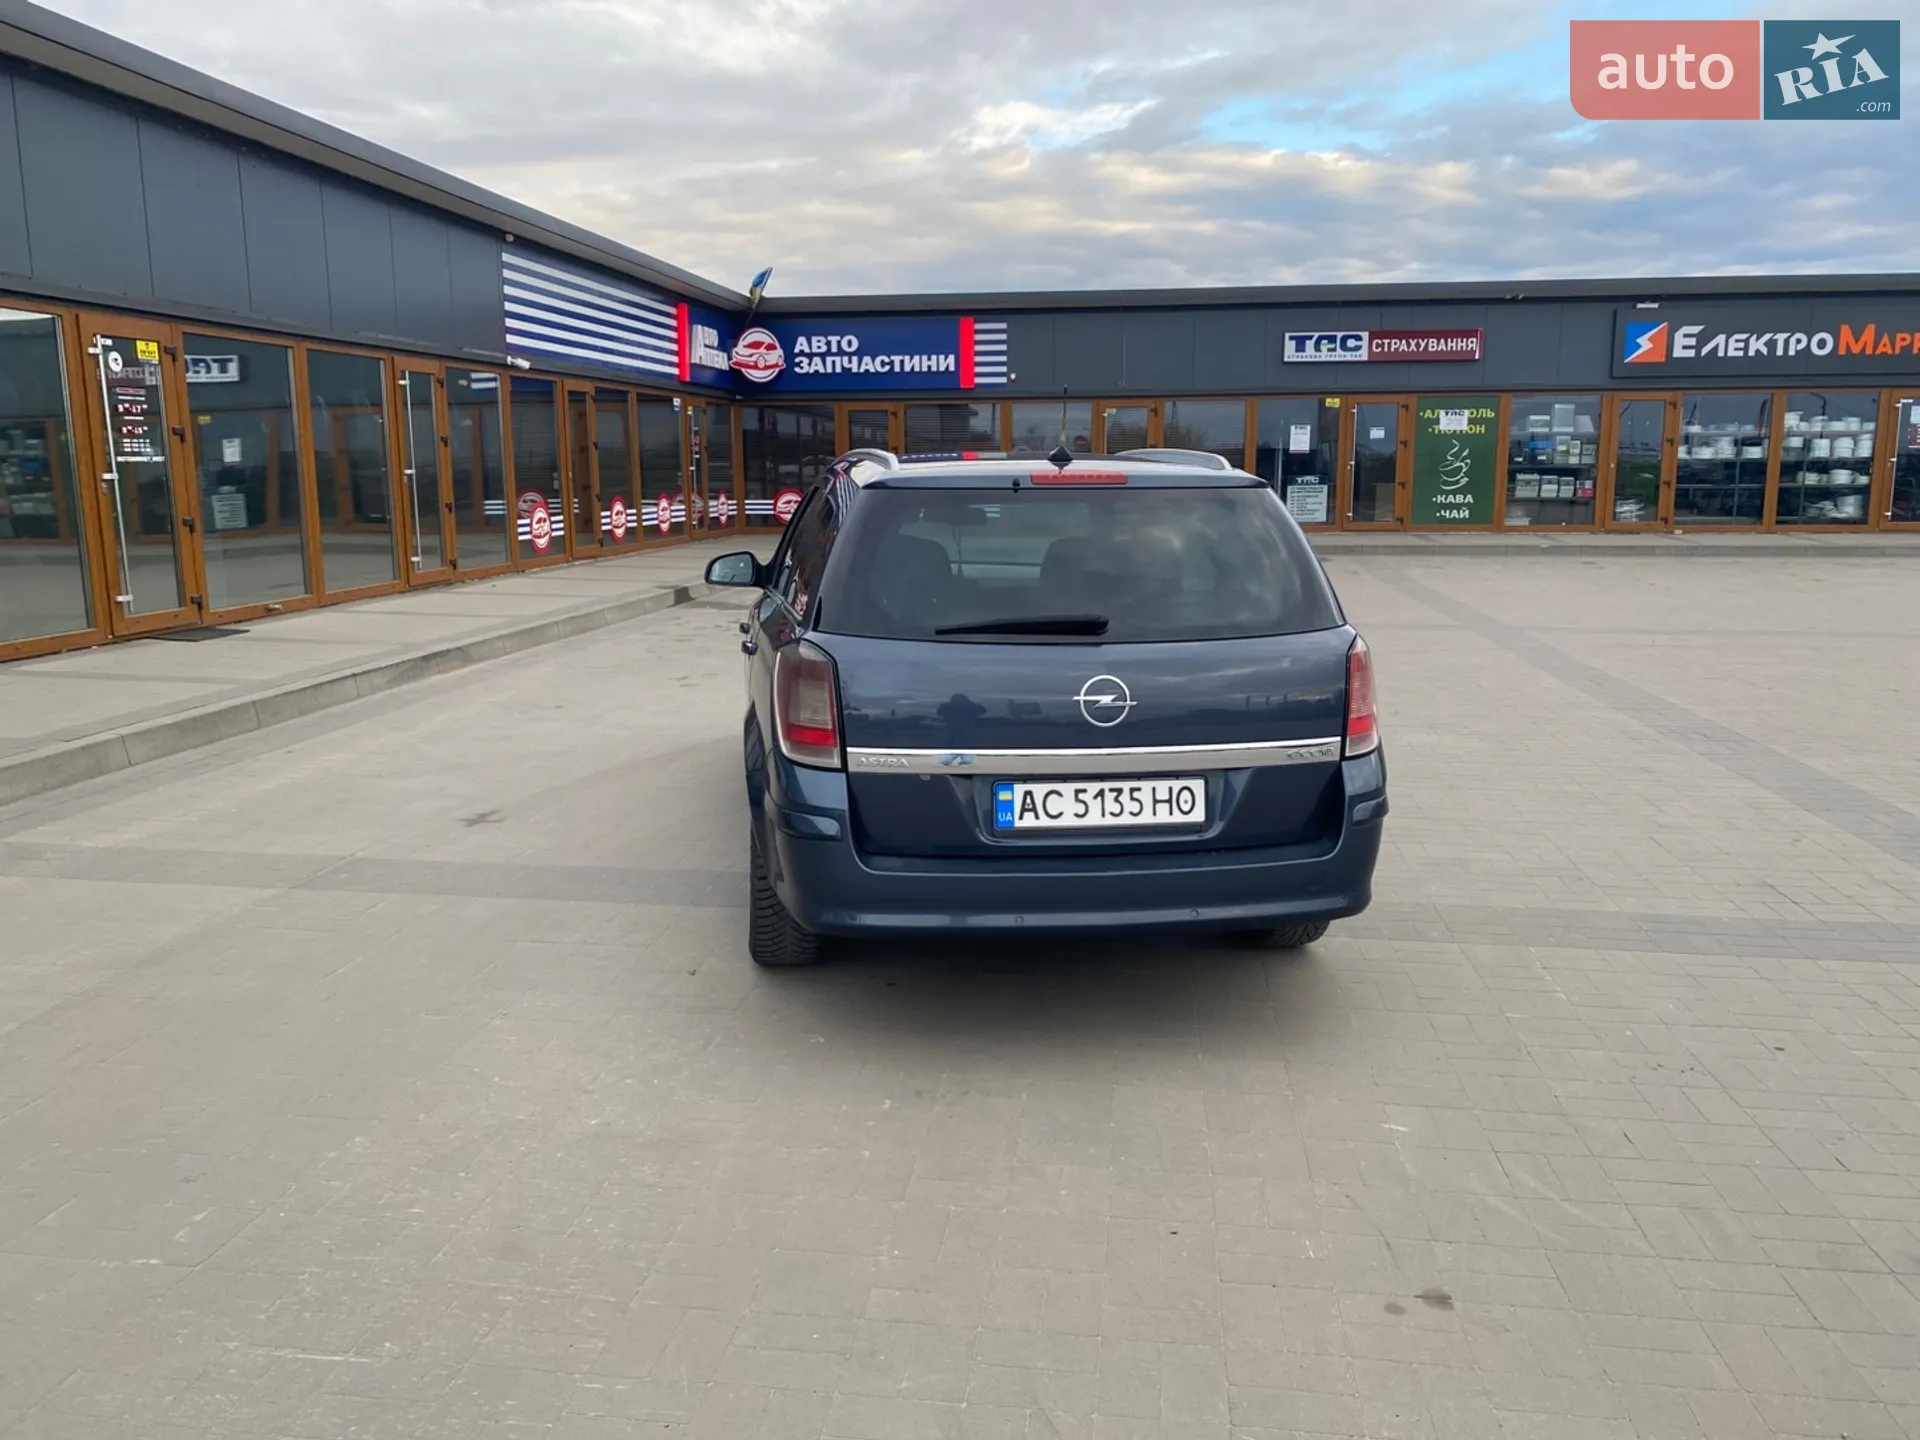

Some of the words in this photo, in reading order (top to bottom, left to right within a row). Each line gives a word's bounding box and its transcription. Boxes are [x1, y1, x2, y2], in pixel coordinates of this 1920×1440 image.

[793, 334, 859, 354] АВТО
[1371, 337, 1477, 352] СТРАХУВАННЯ
[793, 353, 956, 374] ЗАПЧАСТИНИ
[1423, 408, 1496, 419] АЛОЛЬ
[1437, 494, 1474, 504] КАВА
[1440, 507, 1470, 519] ЧАЙ
[857, 756, 910, 768] ASTRA
[1018, 790, 1064, 822] AC
[1073, 786, 1144, 820] 5135
[1152, 785, 1196, 817] HO
[998, 811, 1014, 823] UA
